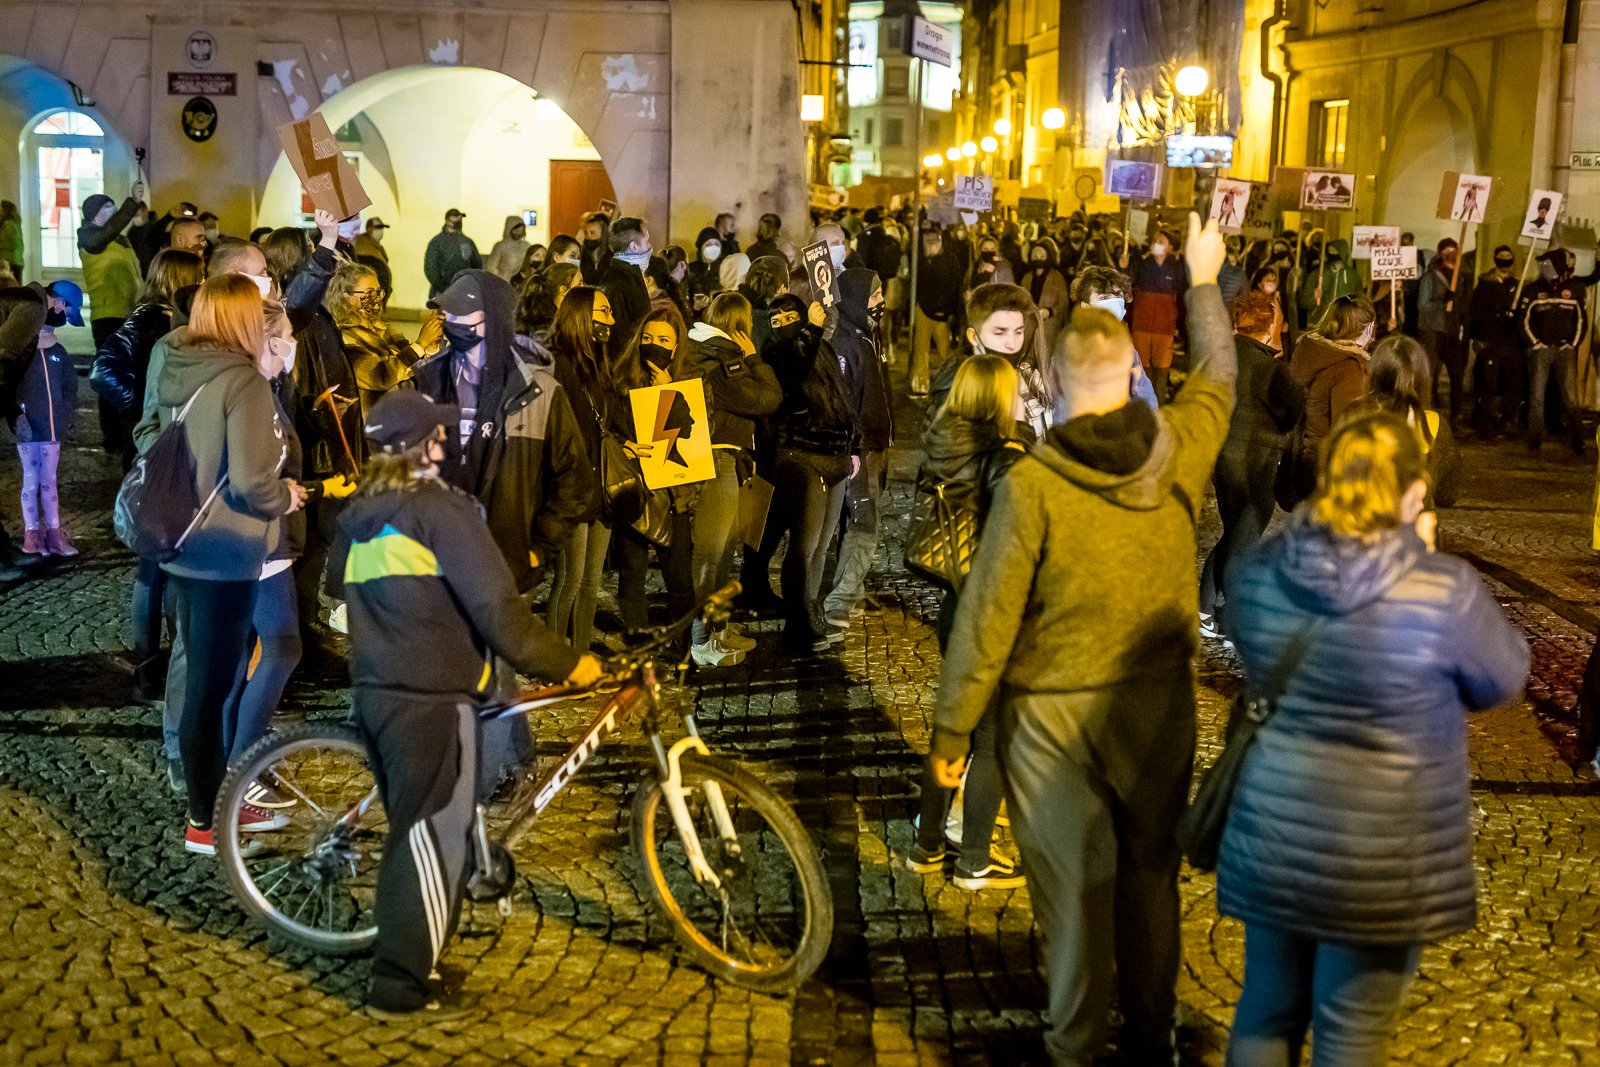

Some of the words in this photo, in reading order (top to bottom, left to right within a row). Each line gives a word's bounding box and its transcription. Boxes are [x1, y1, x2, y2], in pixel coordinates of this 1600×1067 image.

[924, 24, 943, 42] Droga
[1572, 154, 1592, 167] Plac
[964, 176, 984, 191] PIS
[967, 197, 992, 207] OPTION
[533, 704, 619, 816] SCOTT
